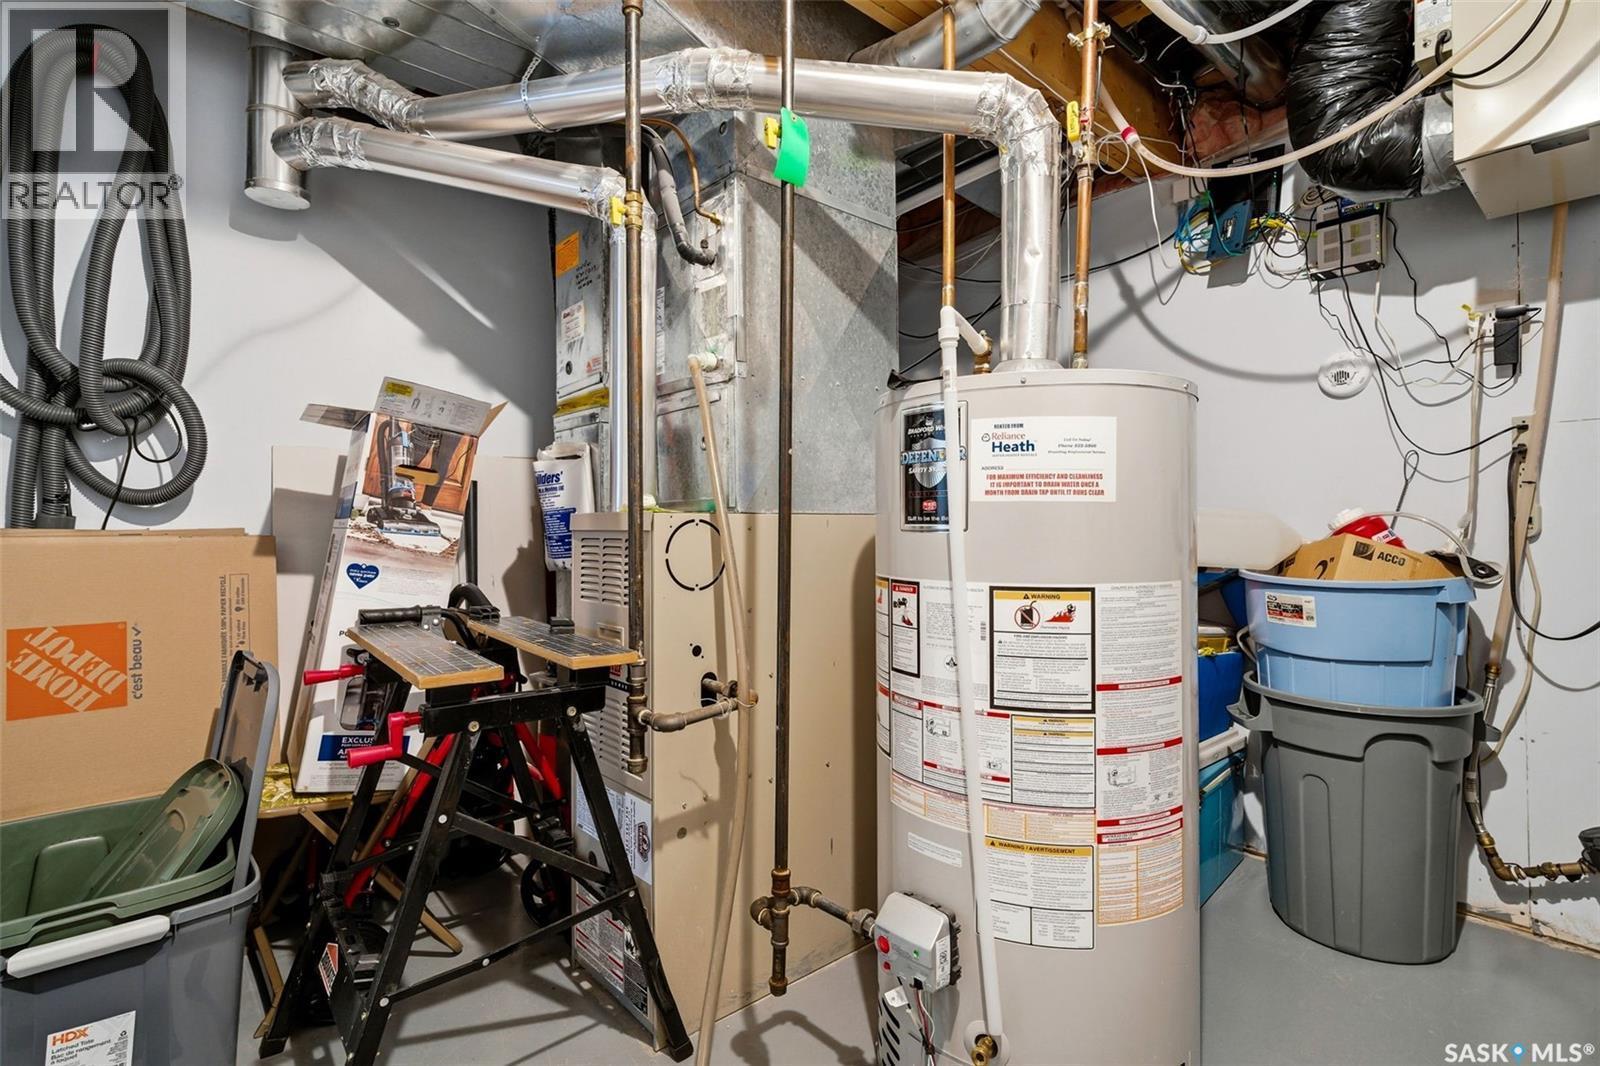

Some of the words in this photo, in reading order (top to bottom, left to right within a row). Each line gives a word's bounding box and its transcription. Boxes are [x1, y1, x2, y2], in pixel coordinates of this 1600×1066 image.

[992, 432, 1026, 440] Reliance
[992, 440, 1035, 452] Heath
[1377, 551, 1406, 566] ACCO
[24, 626, 127, 694] DEPOT
[130, 638, 143, 667] beau
[7, 648, 102, 712] HOME
[130, 668, 143, 700] c'est
[51, 1027, 90, 1046] HDX
